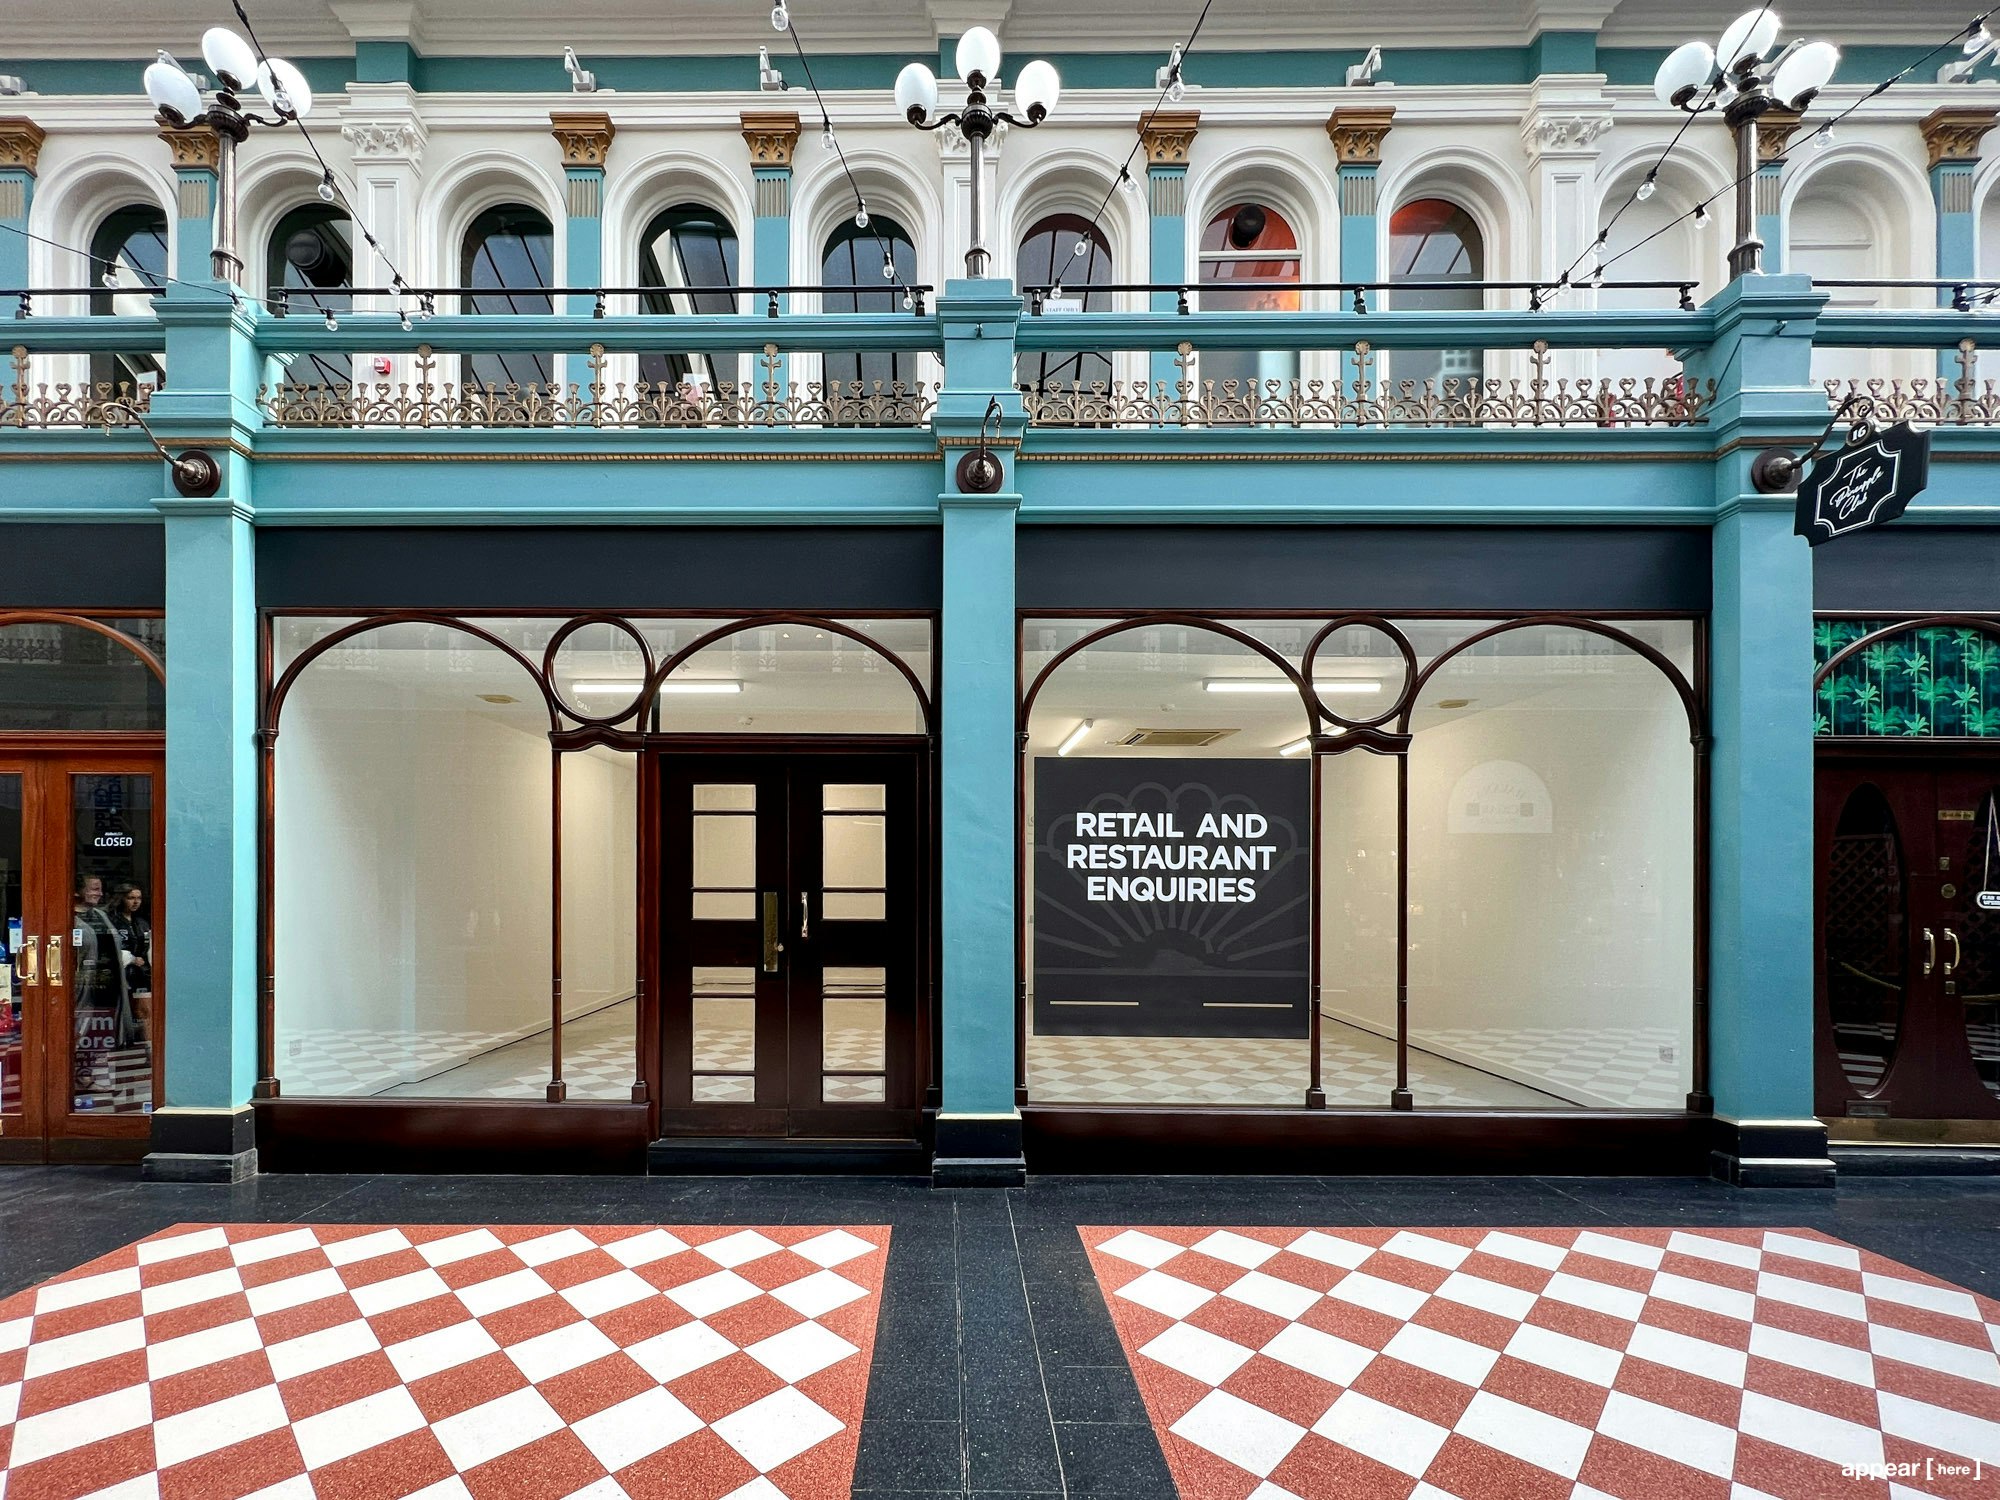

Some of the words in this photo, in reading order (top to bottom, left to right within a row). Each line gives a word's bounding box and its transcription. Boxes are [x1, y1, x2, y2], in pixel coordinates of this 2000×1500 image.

[1852, 426, 1866, 441] 16
[1843, 458, 1872, 486] The
[1839, 491, 1867, 520] Club
[1076, 812, 1184, 838] RETAIL
[1196, 813, 1268, 838] AND
[94, 836, 133, 847] CLOSED
[1067, 844, 1277, 870] RESTAURANT
[1087, 876, 1256, 903] ENQUIRIES
[76, 1036, 115, 1049] ore
